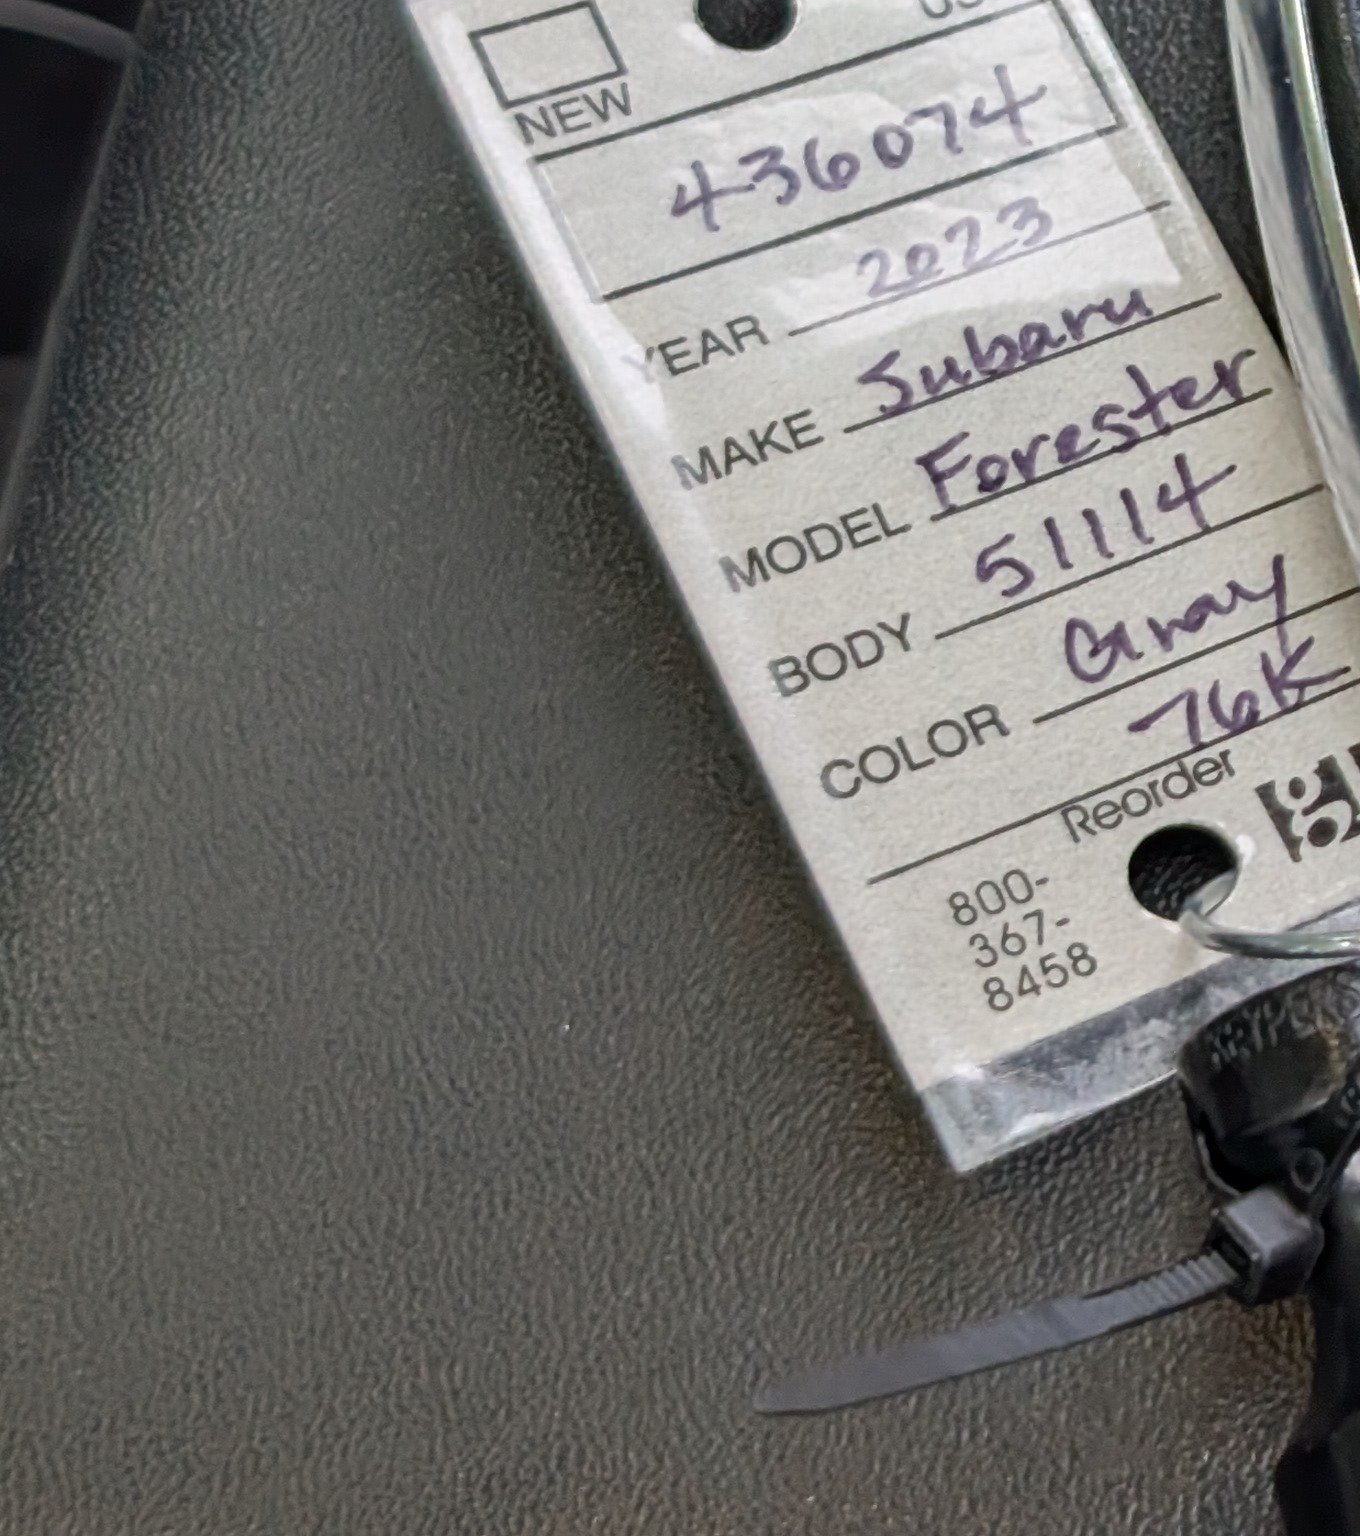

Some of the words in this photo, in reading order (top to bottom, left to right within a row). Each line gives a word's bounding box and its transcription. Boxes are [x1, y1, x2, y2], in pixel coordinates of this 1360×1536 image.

[515, 83, 633, 146] NEW
[669, 65, 1047, 231] 436074
[856, 197, 1053, 297] 2023
[858, 287, 1155, 416] Subaru
[671, 410, 825, 490] MAKE
[915, 349, 1256, 516] Forester
[718, 501, 911, 593] MODEL
[976, 453, 1236, 597] 51114
[769, 613, 916, 696] BODY
[1065, 554, 1292, 683] Gray
[1128, 636, 1350, 746] 76K
[818, 703, 1009, 800] COLOR
[1061, 749, 1235, 843] Reorder
[948, 869, 1050, 926] 800-
[969, 912, 1070, 969] 367-
[982, 942, 1098, 1013] 8458
